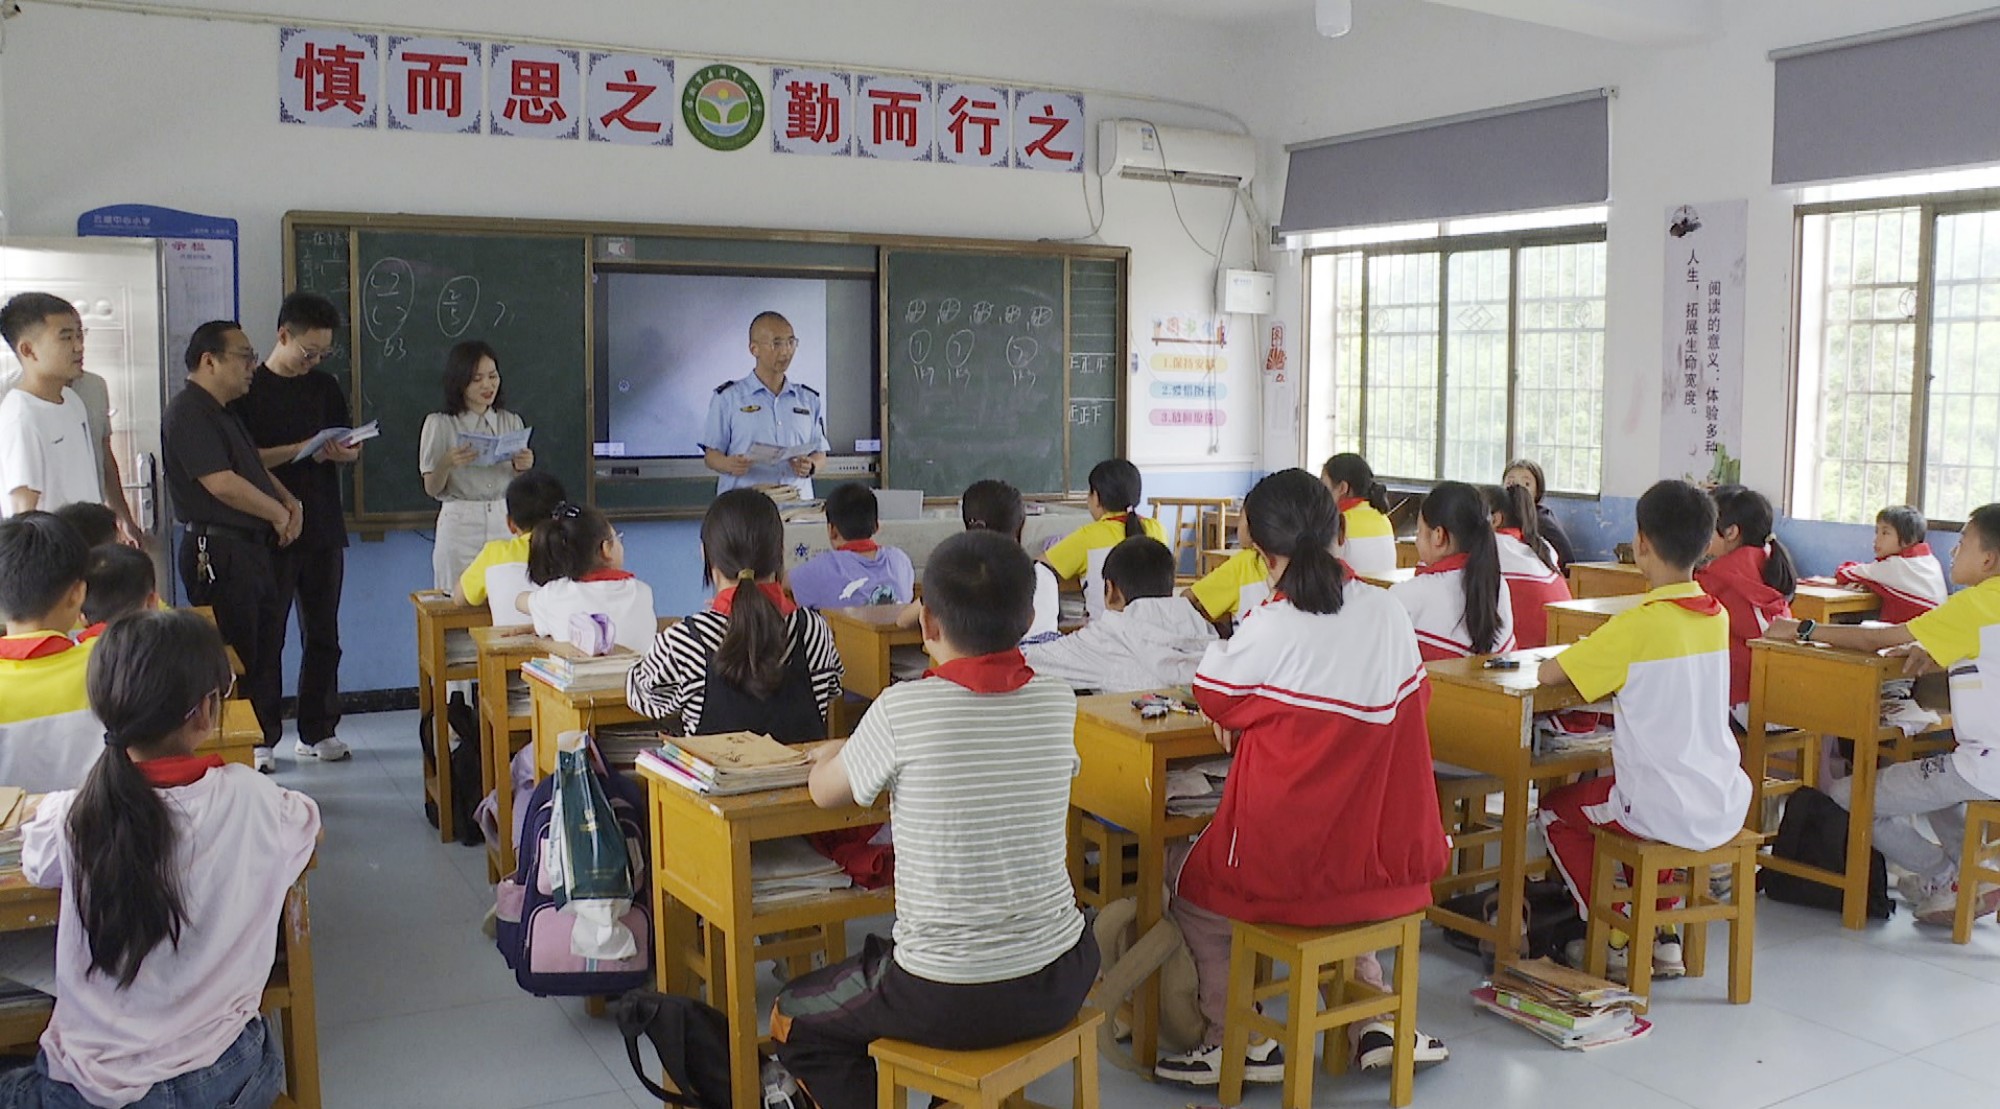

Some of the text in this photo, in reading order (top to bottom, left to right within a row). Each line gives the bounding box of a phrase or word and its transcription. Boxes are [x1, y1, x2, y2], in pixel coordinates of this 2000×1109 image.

[294, 41, 662, 134] 慎而思之
[784, 80, 1074, 162] 勤而行之
